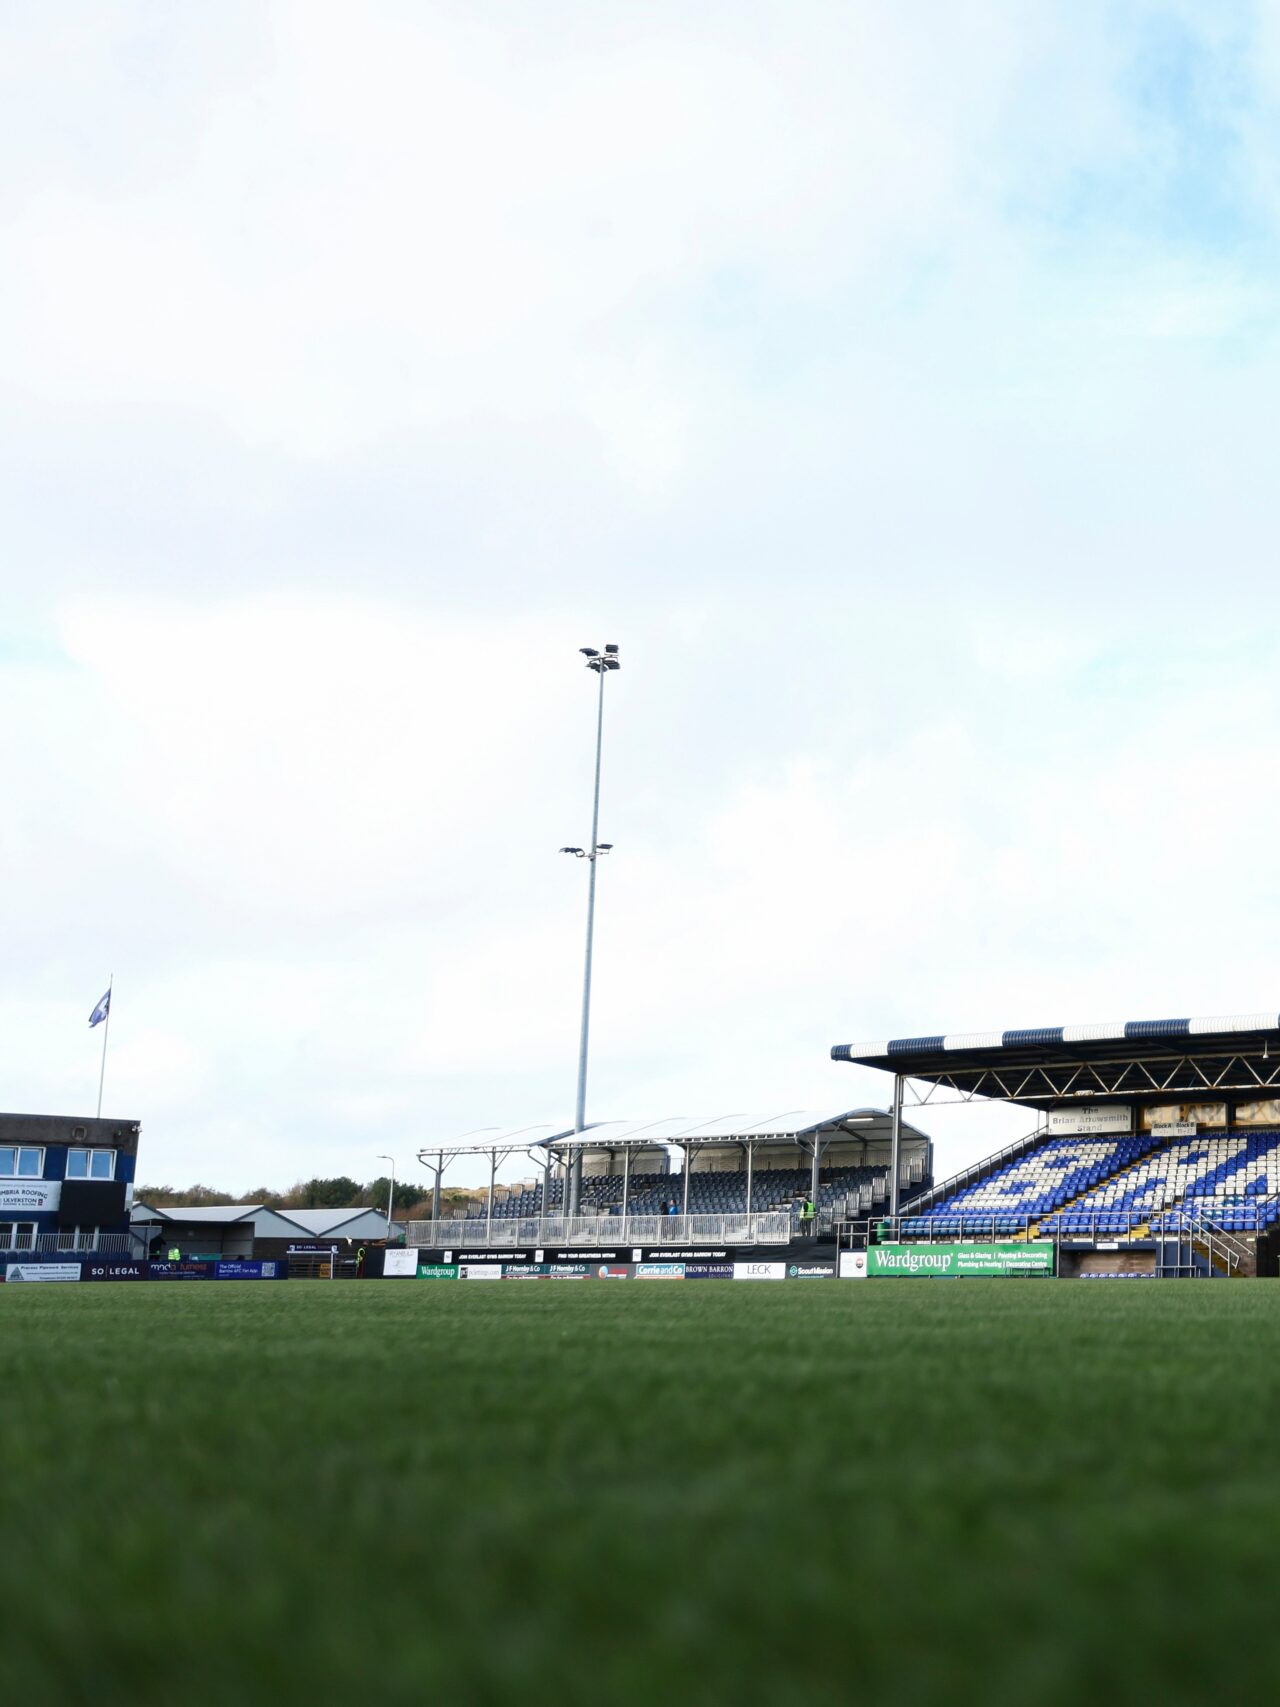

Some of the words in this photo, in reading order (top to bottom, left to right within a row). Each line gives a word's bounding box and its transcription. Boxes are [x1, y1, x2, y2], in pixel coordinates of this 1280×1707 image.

[1078, 1115, 1128, 1124] Arrowsmith
[1077, 1124, 1102, 1132] Stand
[975, 1252, 991, 1260] Glazing
[998, 1252, 1017, 1260] Painting
[1023, 1252, 1048, 1260] Decorating
[874, 1250, 951, 1272] Wardgroup
[109, 1267, 139, 1275] LEGAL
[421, 1265, 455, 1278] Wardgroup
[513, 1265, 529, 1273] Hornby
[557, 1265, 574, 1273] Hornby
[639, 1266, 660, 1275] Corrie
[660, 1266, 672, 1274] and
[673, 1266, 682, 1274] Co
[747, 1264, 771, 1274] LECK
